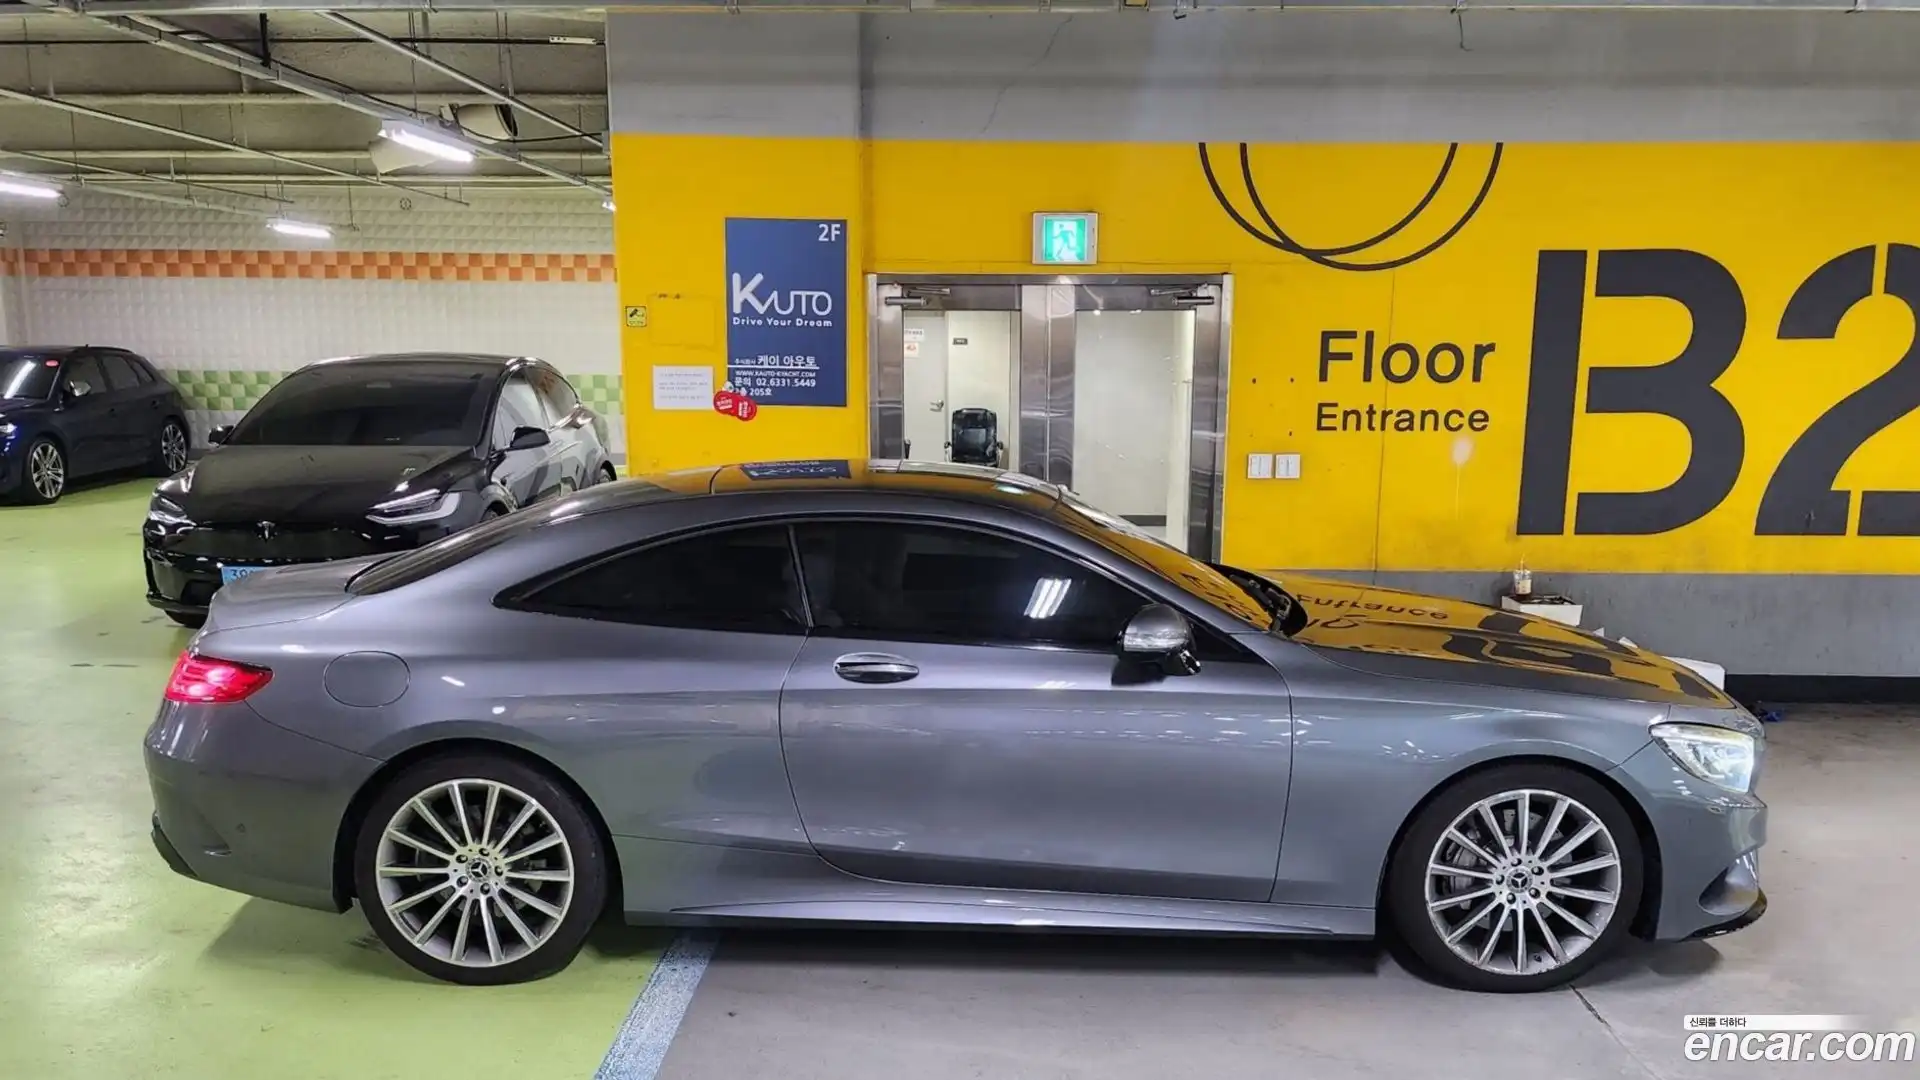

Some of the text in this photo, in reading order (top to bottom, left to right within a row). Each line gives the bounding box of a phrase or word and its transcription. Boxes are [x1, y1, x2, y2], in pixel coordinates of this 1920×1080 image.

[818, 223, 841, 242] 2F
[732, 316, 833, 327] Drive Your Dream
[757, 354, 780, 367] 케이
[782, 355, 817, 367] 아우토
[1318, 330, 1495, 384] Floor
[734, 377, 816, 388] 문의 02.6331.5449
[1516, 242, 1920, 536] B2
[749, 387, 773, 397] 205호
[1316, 402, 1490, 432] Entrance
